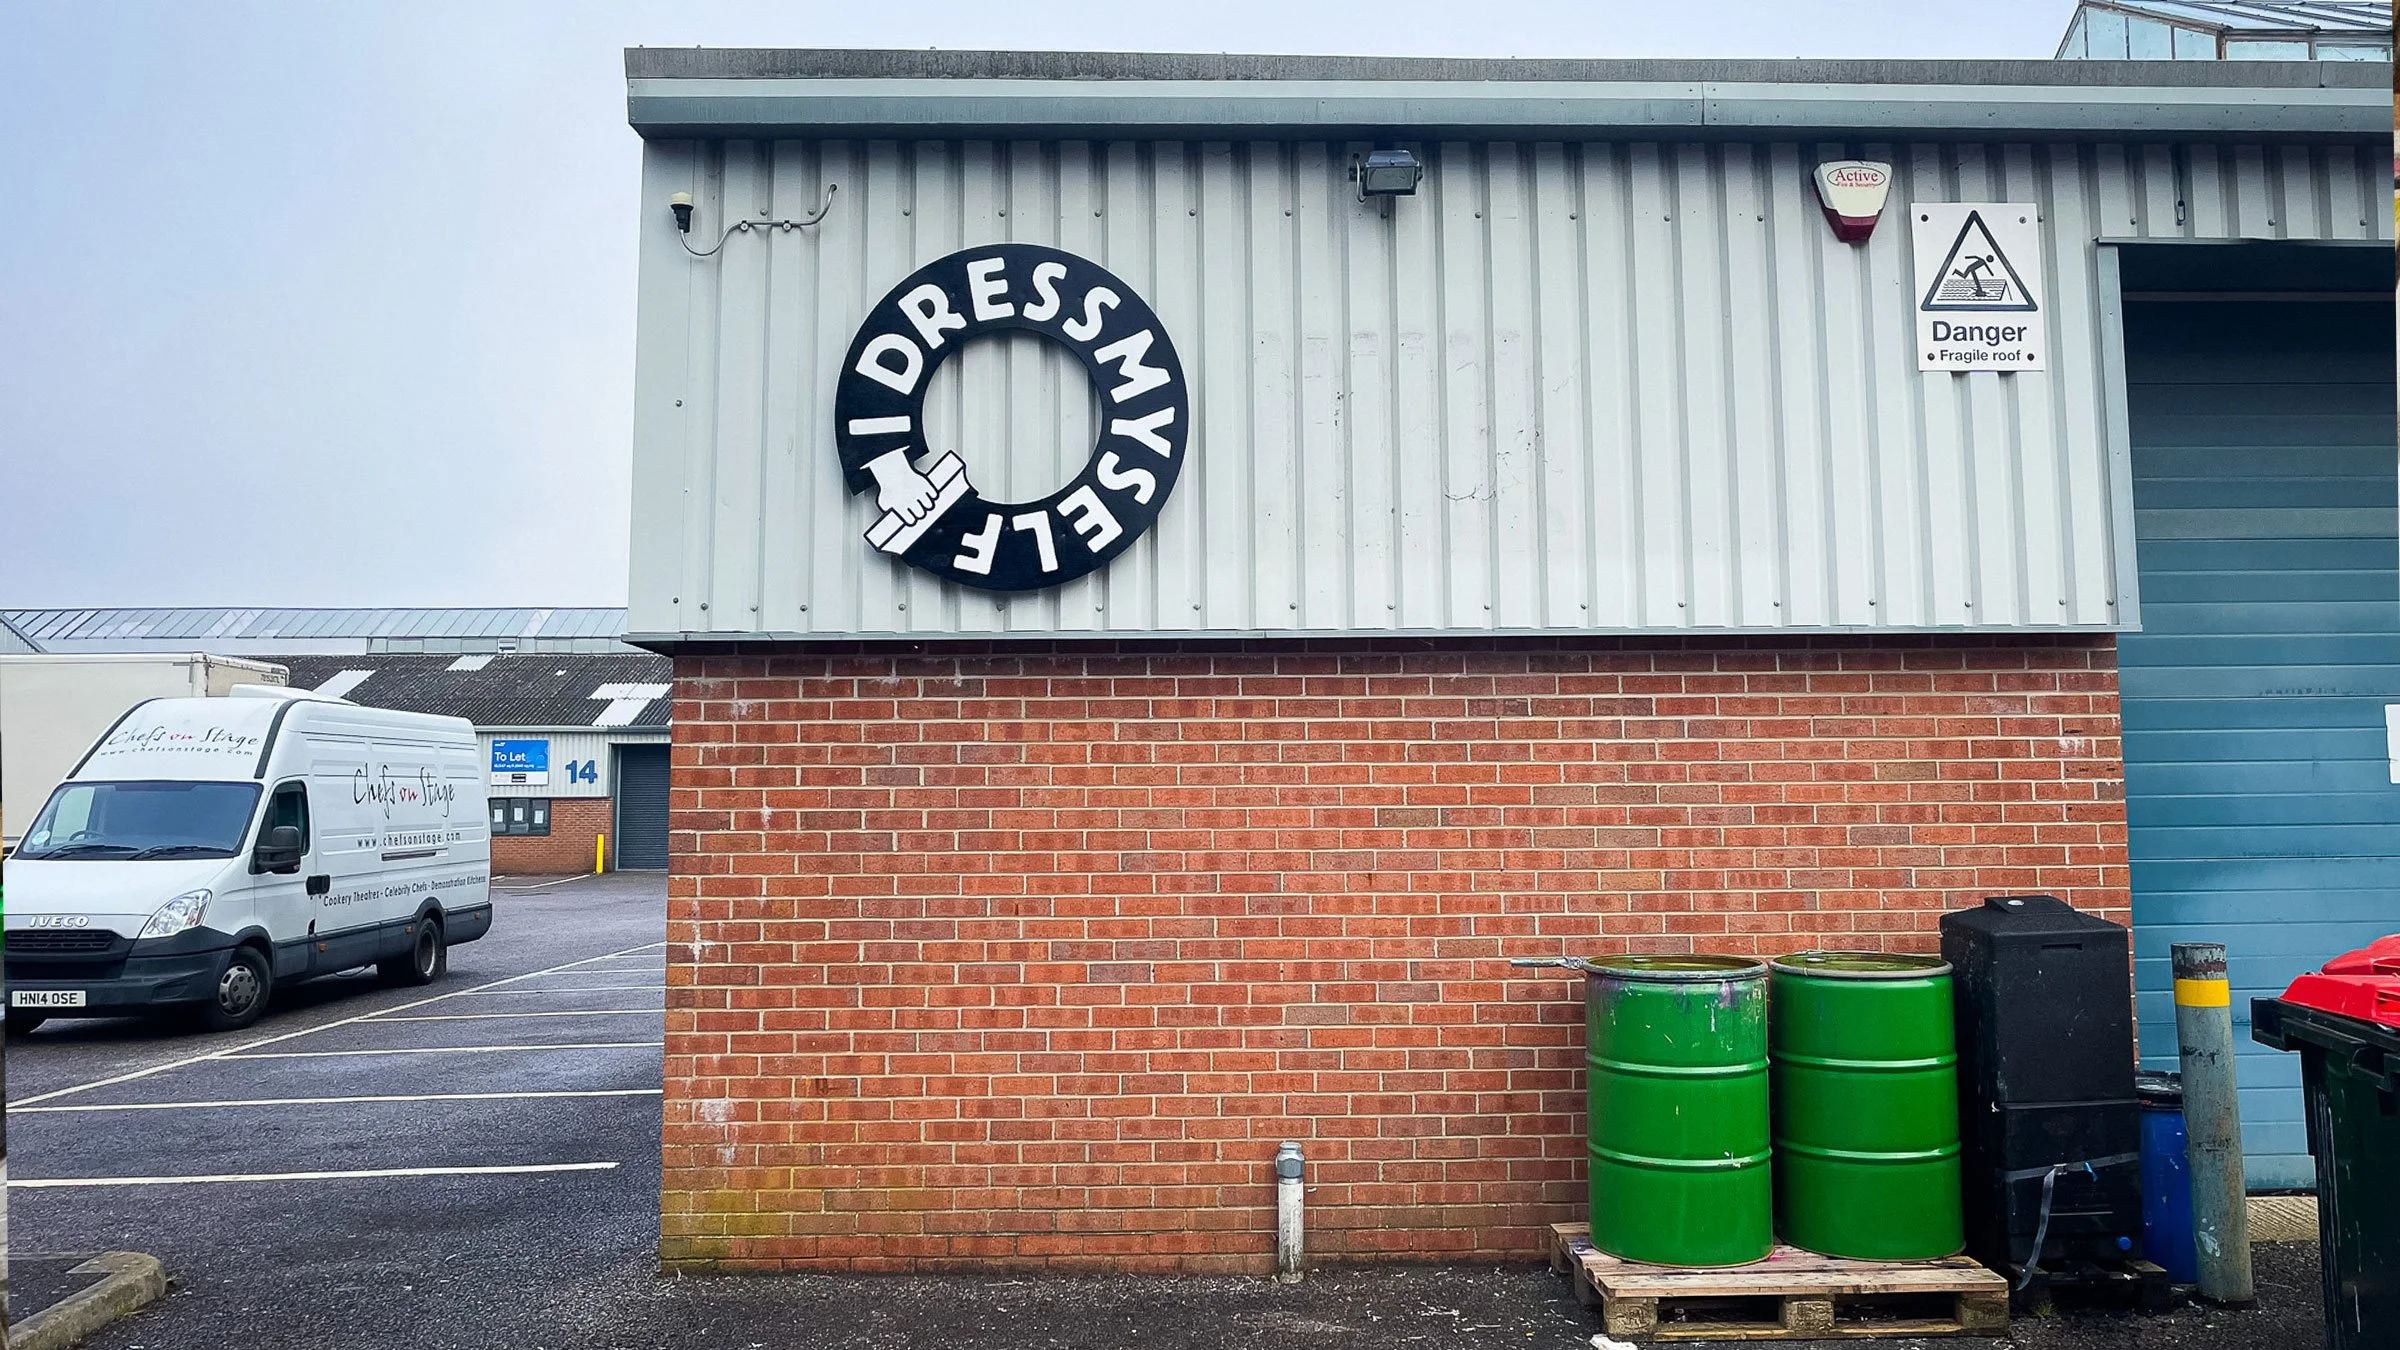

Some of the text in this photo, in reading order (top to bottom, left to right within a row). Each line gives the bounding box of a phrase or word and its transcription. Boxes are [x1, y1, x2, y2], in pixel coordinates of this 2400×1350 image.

[1835, 169, 1878, 182] Active
[1932, 320, 2027, 347] Danger
[1940, 349, 2021, 364] Fragile roof
[107, 726, 259, 749] Chefs on Stage
[494, 751, 526, 762] To Let
[565, 760, 598, 784] 14
[353, 763, 455, 820] Chefs on Stage
[323, 894, 351, 907] Cookery
[353, 889, 380, 902] Theatres
[384, 885, 410, 898] Celebrity
[412, 881, 428, 893] Chefs
[29, 916, 89, 928] IVECO
[20, 992, 78, 1005] HN14 OSE
